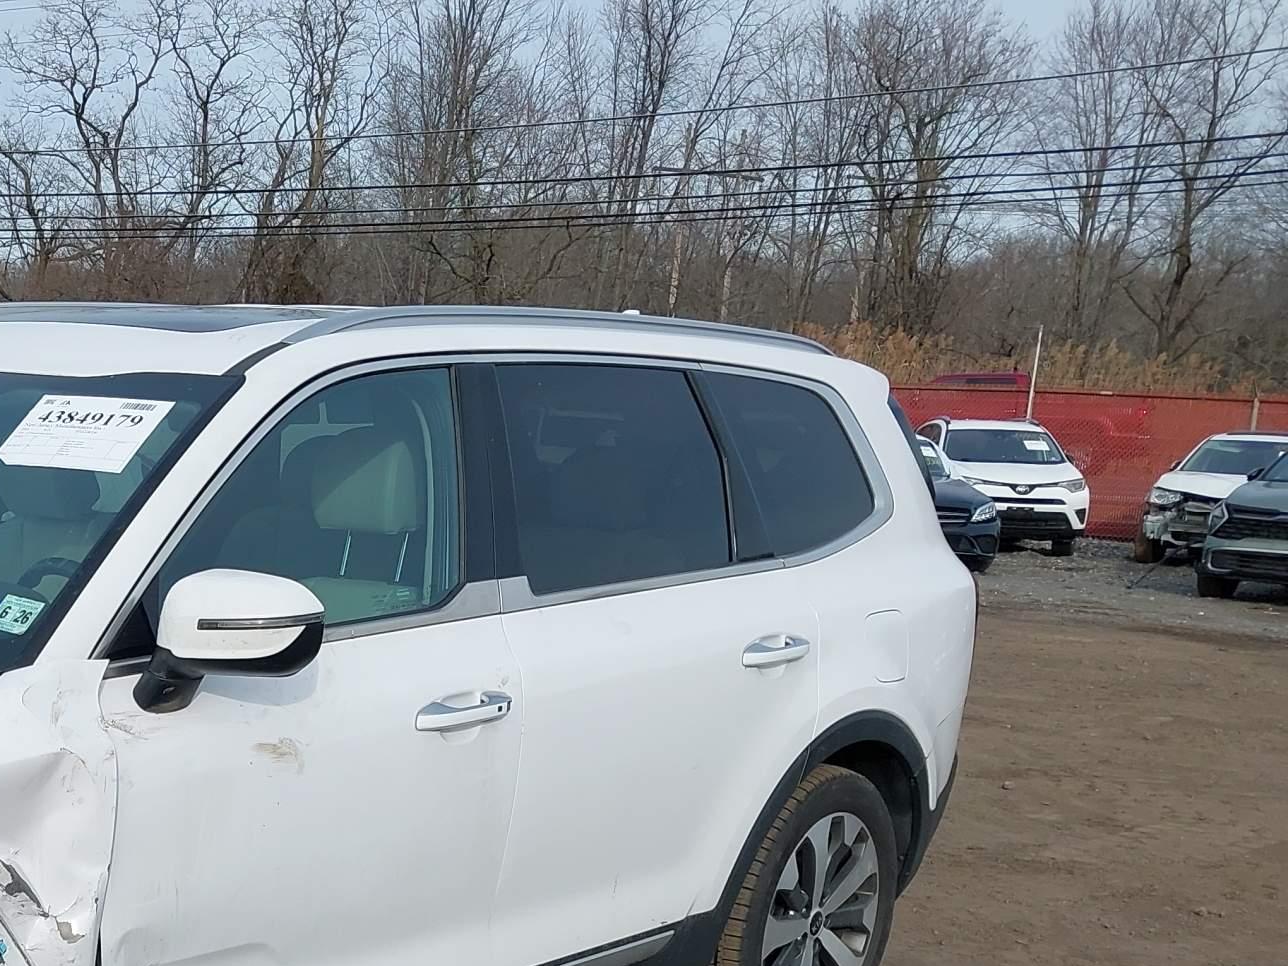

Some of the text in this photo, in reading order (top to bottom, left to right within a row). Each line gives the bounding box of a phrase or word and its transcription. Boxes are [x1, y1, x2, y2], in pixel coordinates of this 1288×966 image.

[38, 410, 143, 428] 43849179
[0, 605, 12, 619] 6
[13, 610, 33, 625] 26
